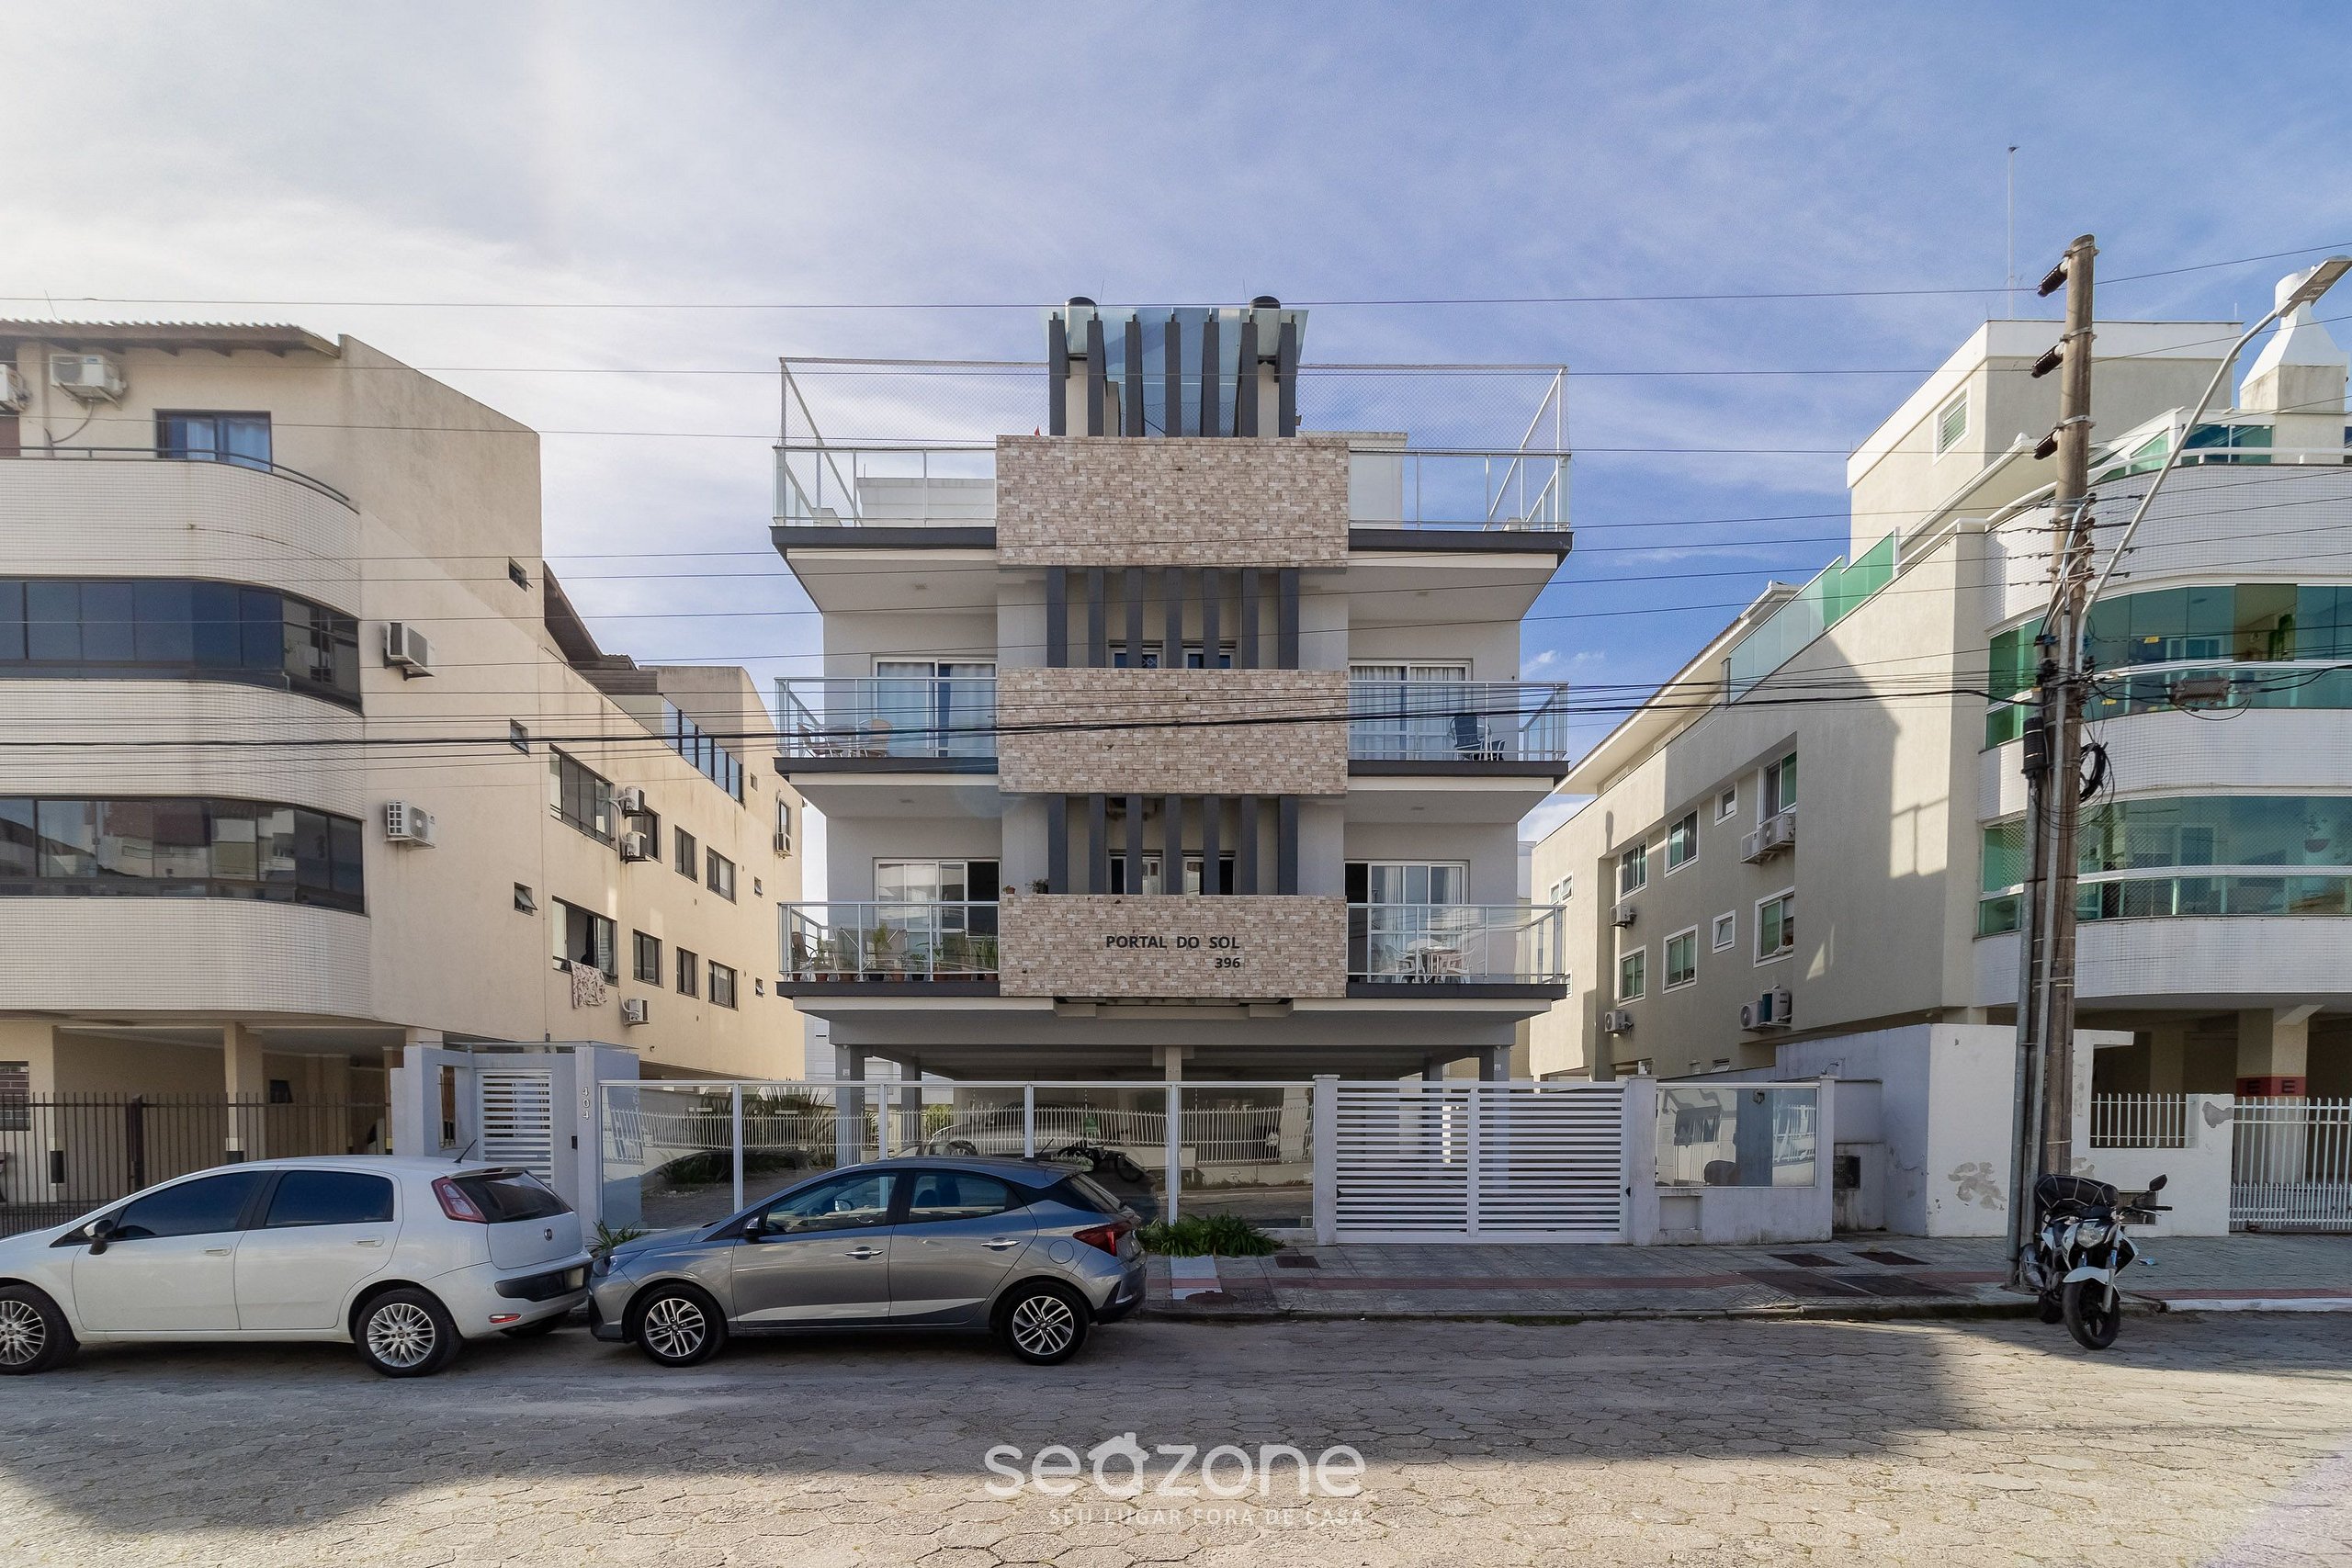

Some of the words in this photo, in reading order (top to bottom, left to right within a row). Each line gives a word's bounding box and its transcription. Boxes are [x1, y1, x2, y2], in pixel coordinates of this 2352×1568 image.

[1106, 935, 1167, 948] PORTAL
[1177, 936, 1199, 948] DO
[1209, 936, 1239, 949] SOL
[1215, 957, 1240, 968] 396
[582, 1087, 590, 1120] 404
